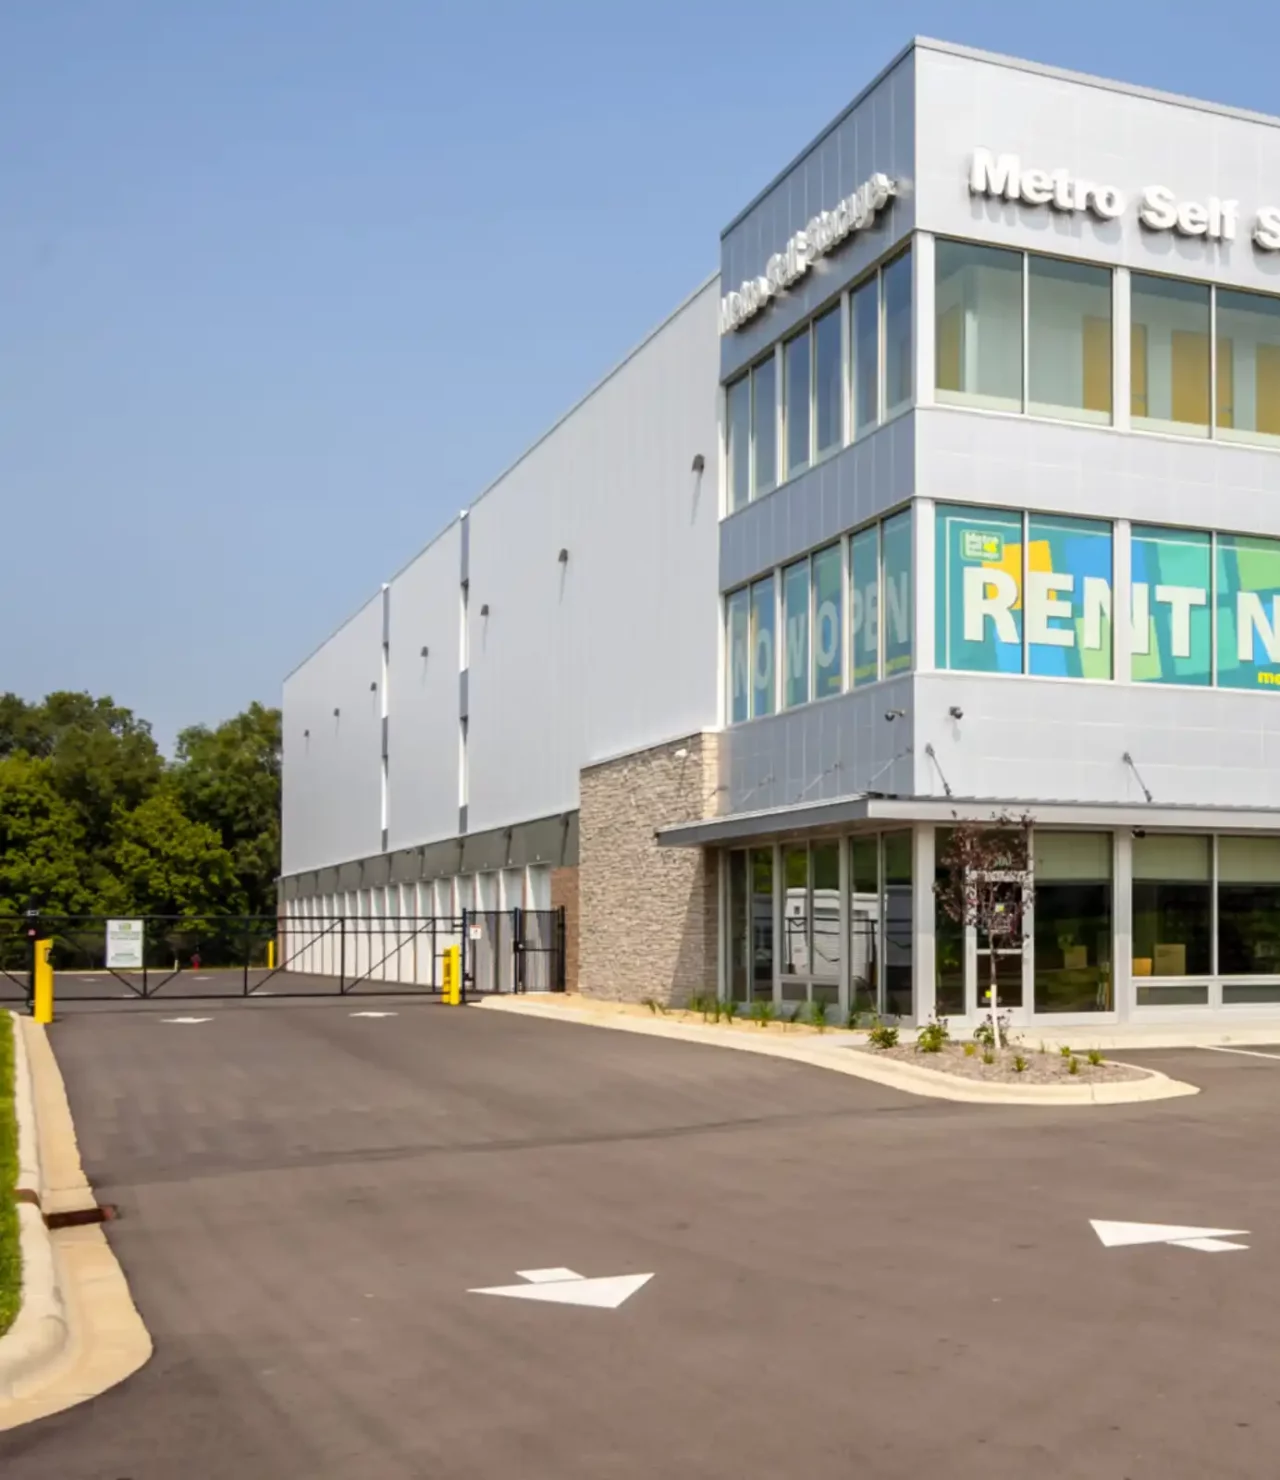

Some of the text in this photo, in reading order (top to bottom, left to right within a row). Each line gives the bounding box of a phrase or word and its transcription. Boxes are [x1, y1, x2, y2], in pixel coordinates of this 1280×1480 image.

[969, 148, 1127, 220] Metro
[1140, 184, 1239, 240] Self
[816, 571, 908, 668] OPEN
[963, 566, 1207, 658] RENT
